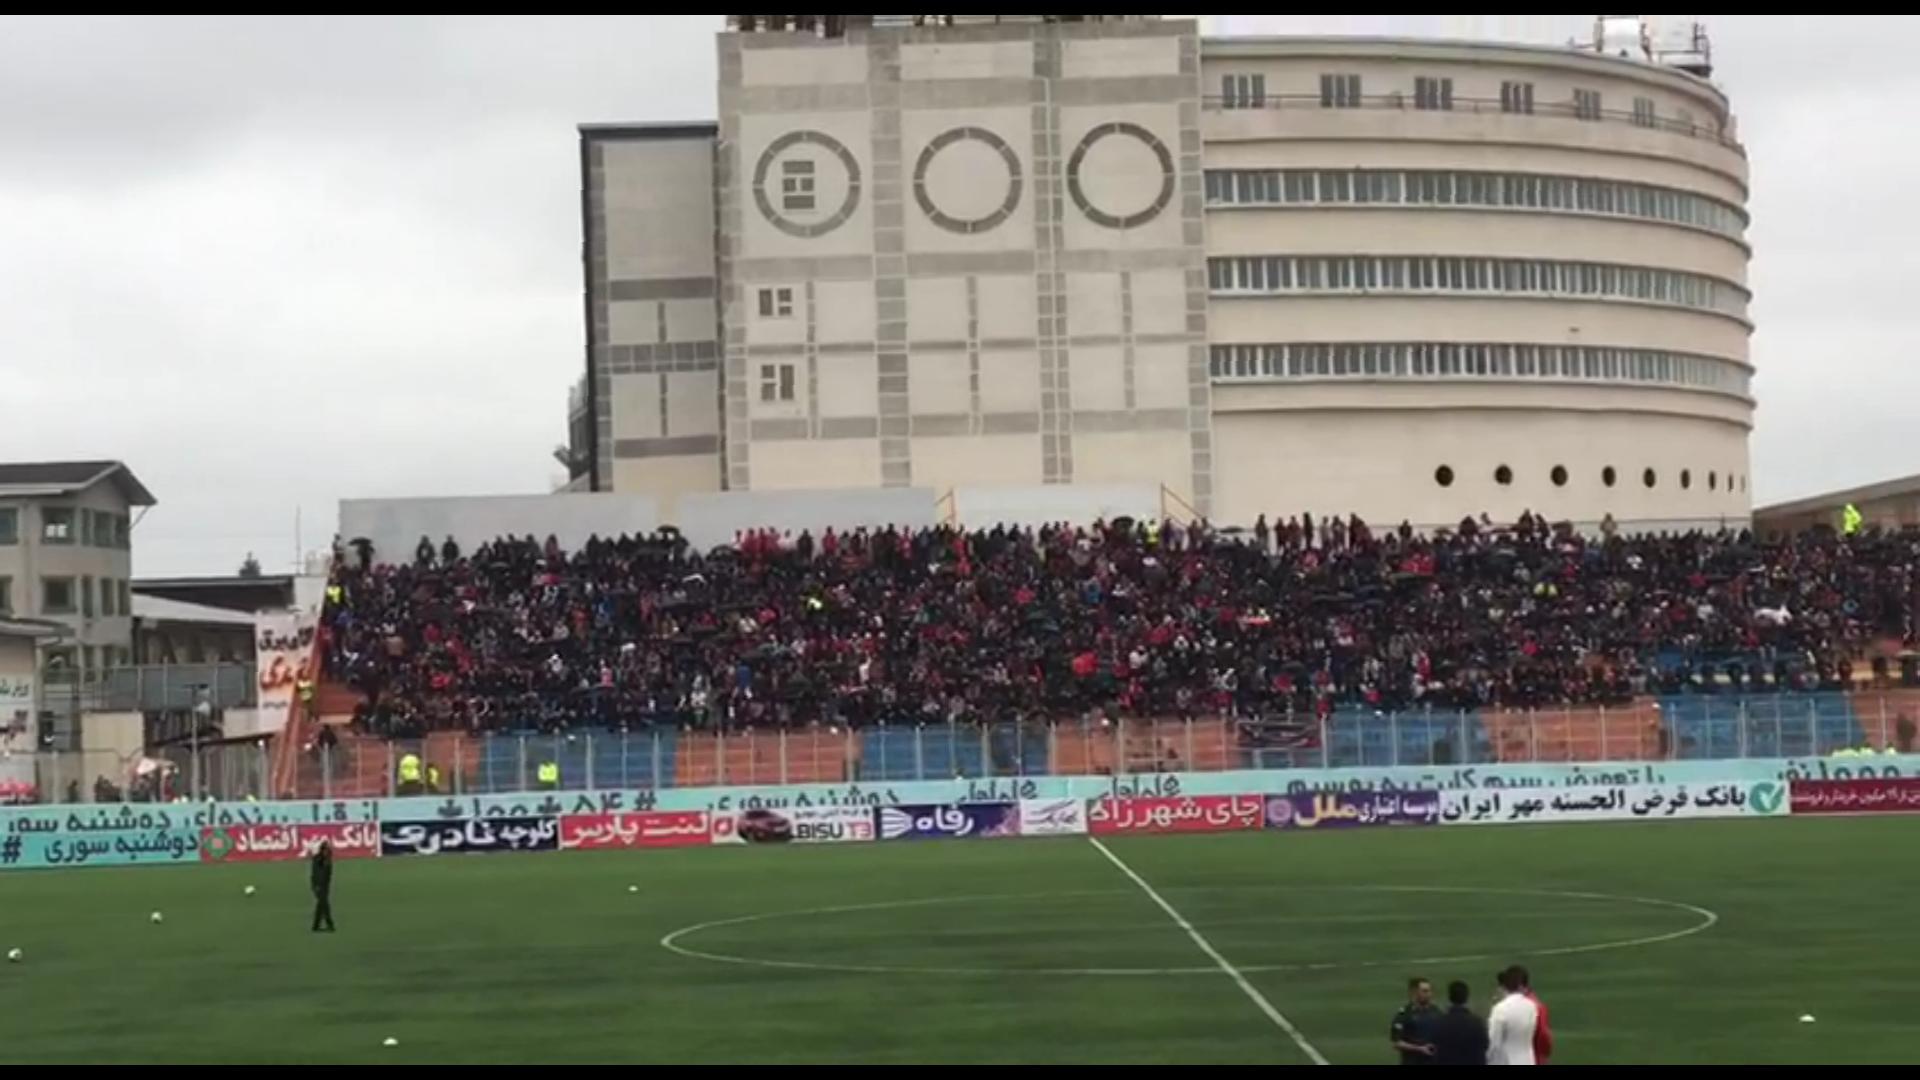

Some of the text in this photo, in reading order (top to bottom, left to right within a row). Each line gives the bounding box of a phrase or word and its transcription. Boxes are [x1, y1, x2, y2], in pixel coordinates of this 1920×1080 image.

[1205, 796, 1260, 827] چای
[1442, 793, 1500, 821] ایران
[1508, 797, 1545, 819] مهر
[1631, 786, 1688, 815] قرض
[1694, 785, 1746, 811] بانک
[561, 813, 708, 849] لنت پارس
[916, 804, 975, 837] رفاه
[44, 829, 199, 864] دوشنبه سوری
[235, 824, 299, 852] اقتصاد
[332, 823, 377, 849] بانک
[383, 819, 556, 855] کلوچه نادری
